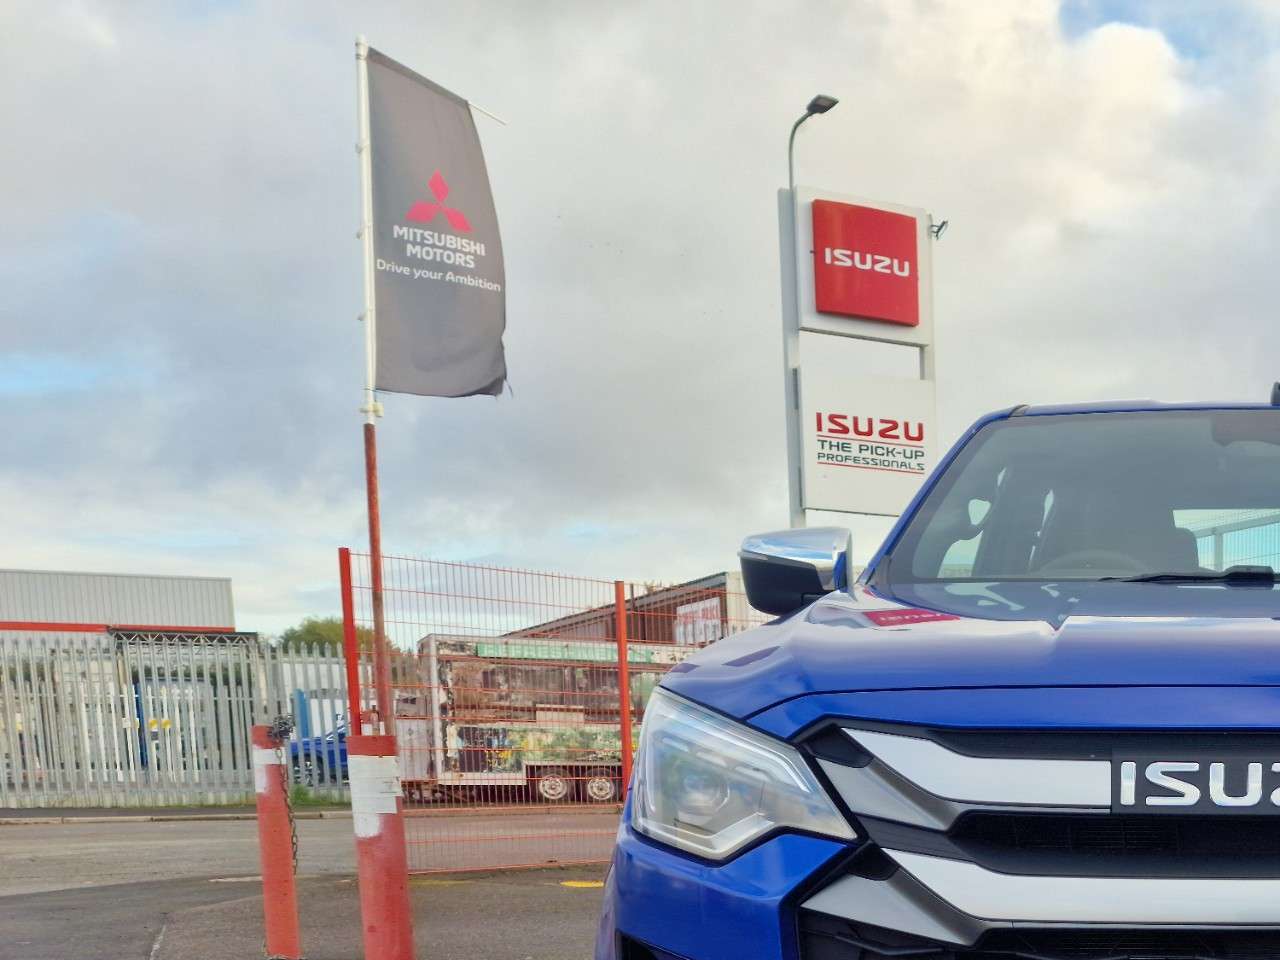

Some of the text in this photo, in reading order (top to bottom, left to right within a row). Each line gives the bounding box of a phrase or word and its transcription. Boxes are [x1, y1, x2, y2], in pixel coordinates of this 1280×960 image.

[392, 225, 486, 256] MITSUBISHI
[406, 243, 475, 269] MOTORS
[824, 247, 910, 277] ISUZU
[376, 259, 501, 292] Drive your Ambition
[815, 412, 924, 442] ISUZU
[817, 439, 924, 459] THE PICK-UP
[817, 452, 924, 471] PROFESSIONALS
